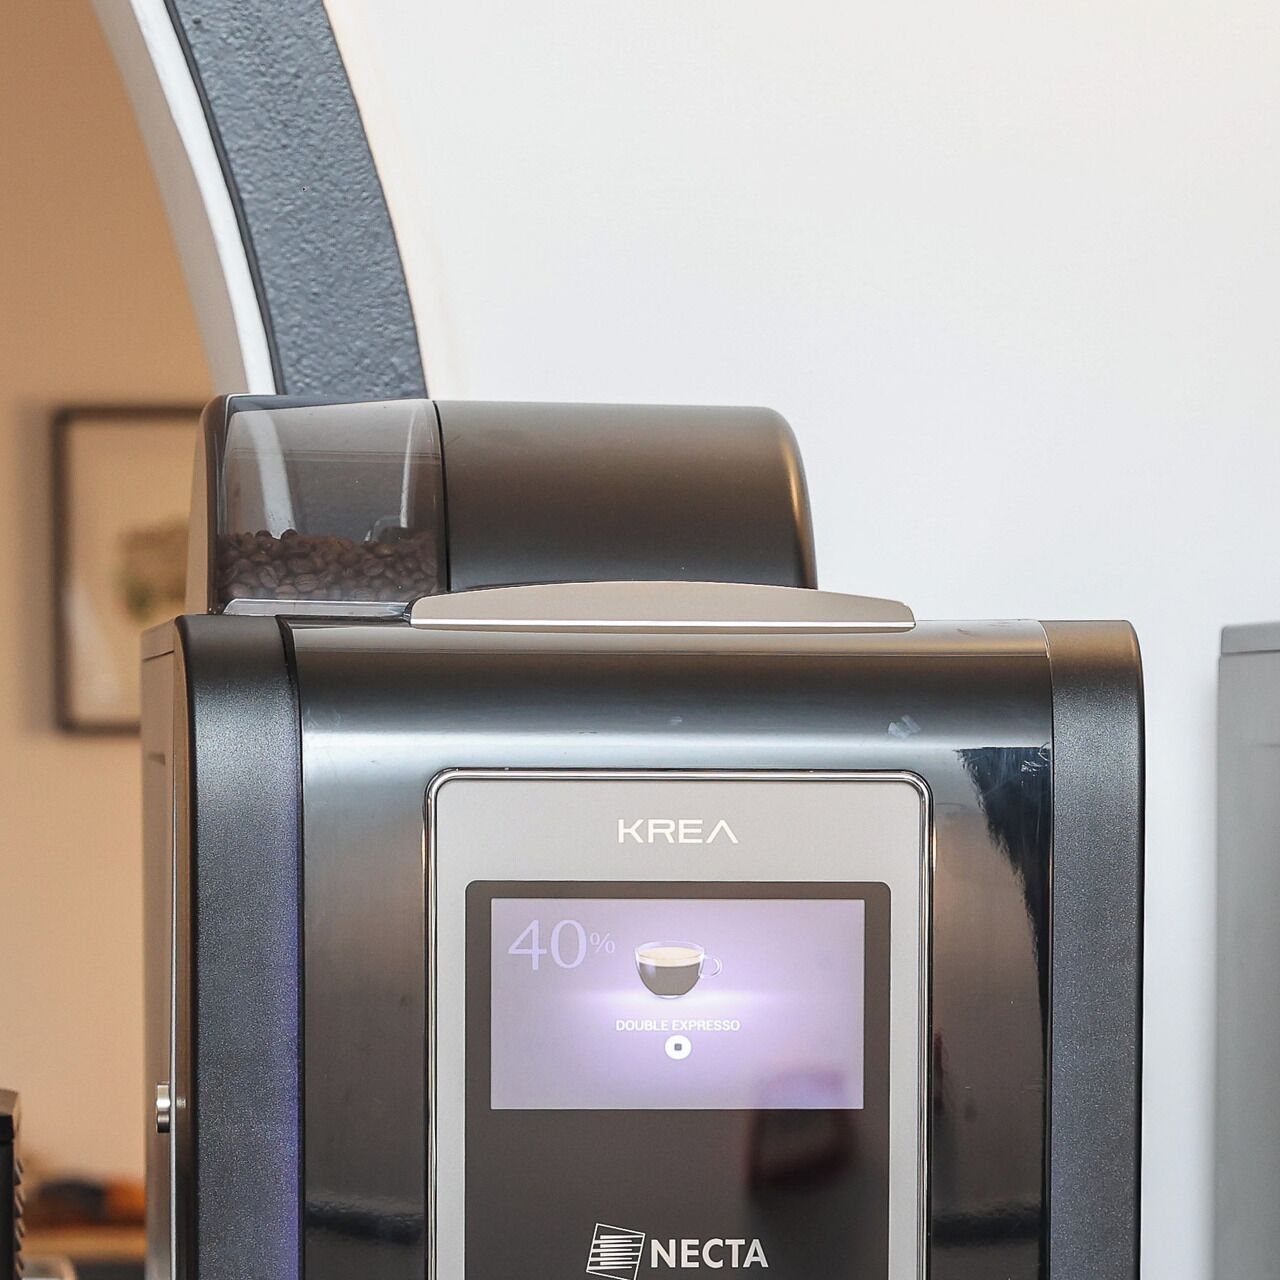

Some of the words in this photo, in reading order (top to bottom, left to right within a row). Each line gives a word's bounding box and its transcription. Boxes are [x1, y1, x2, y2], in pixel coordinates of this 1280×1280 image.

[617, 818, 739, 844] KREA
[616, 1019, 671, 1032] DOUBLE
[672, 1019, 741, 1032] EXPRESSO
[650, 1238, 769, 1269] NECTA
